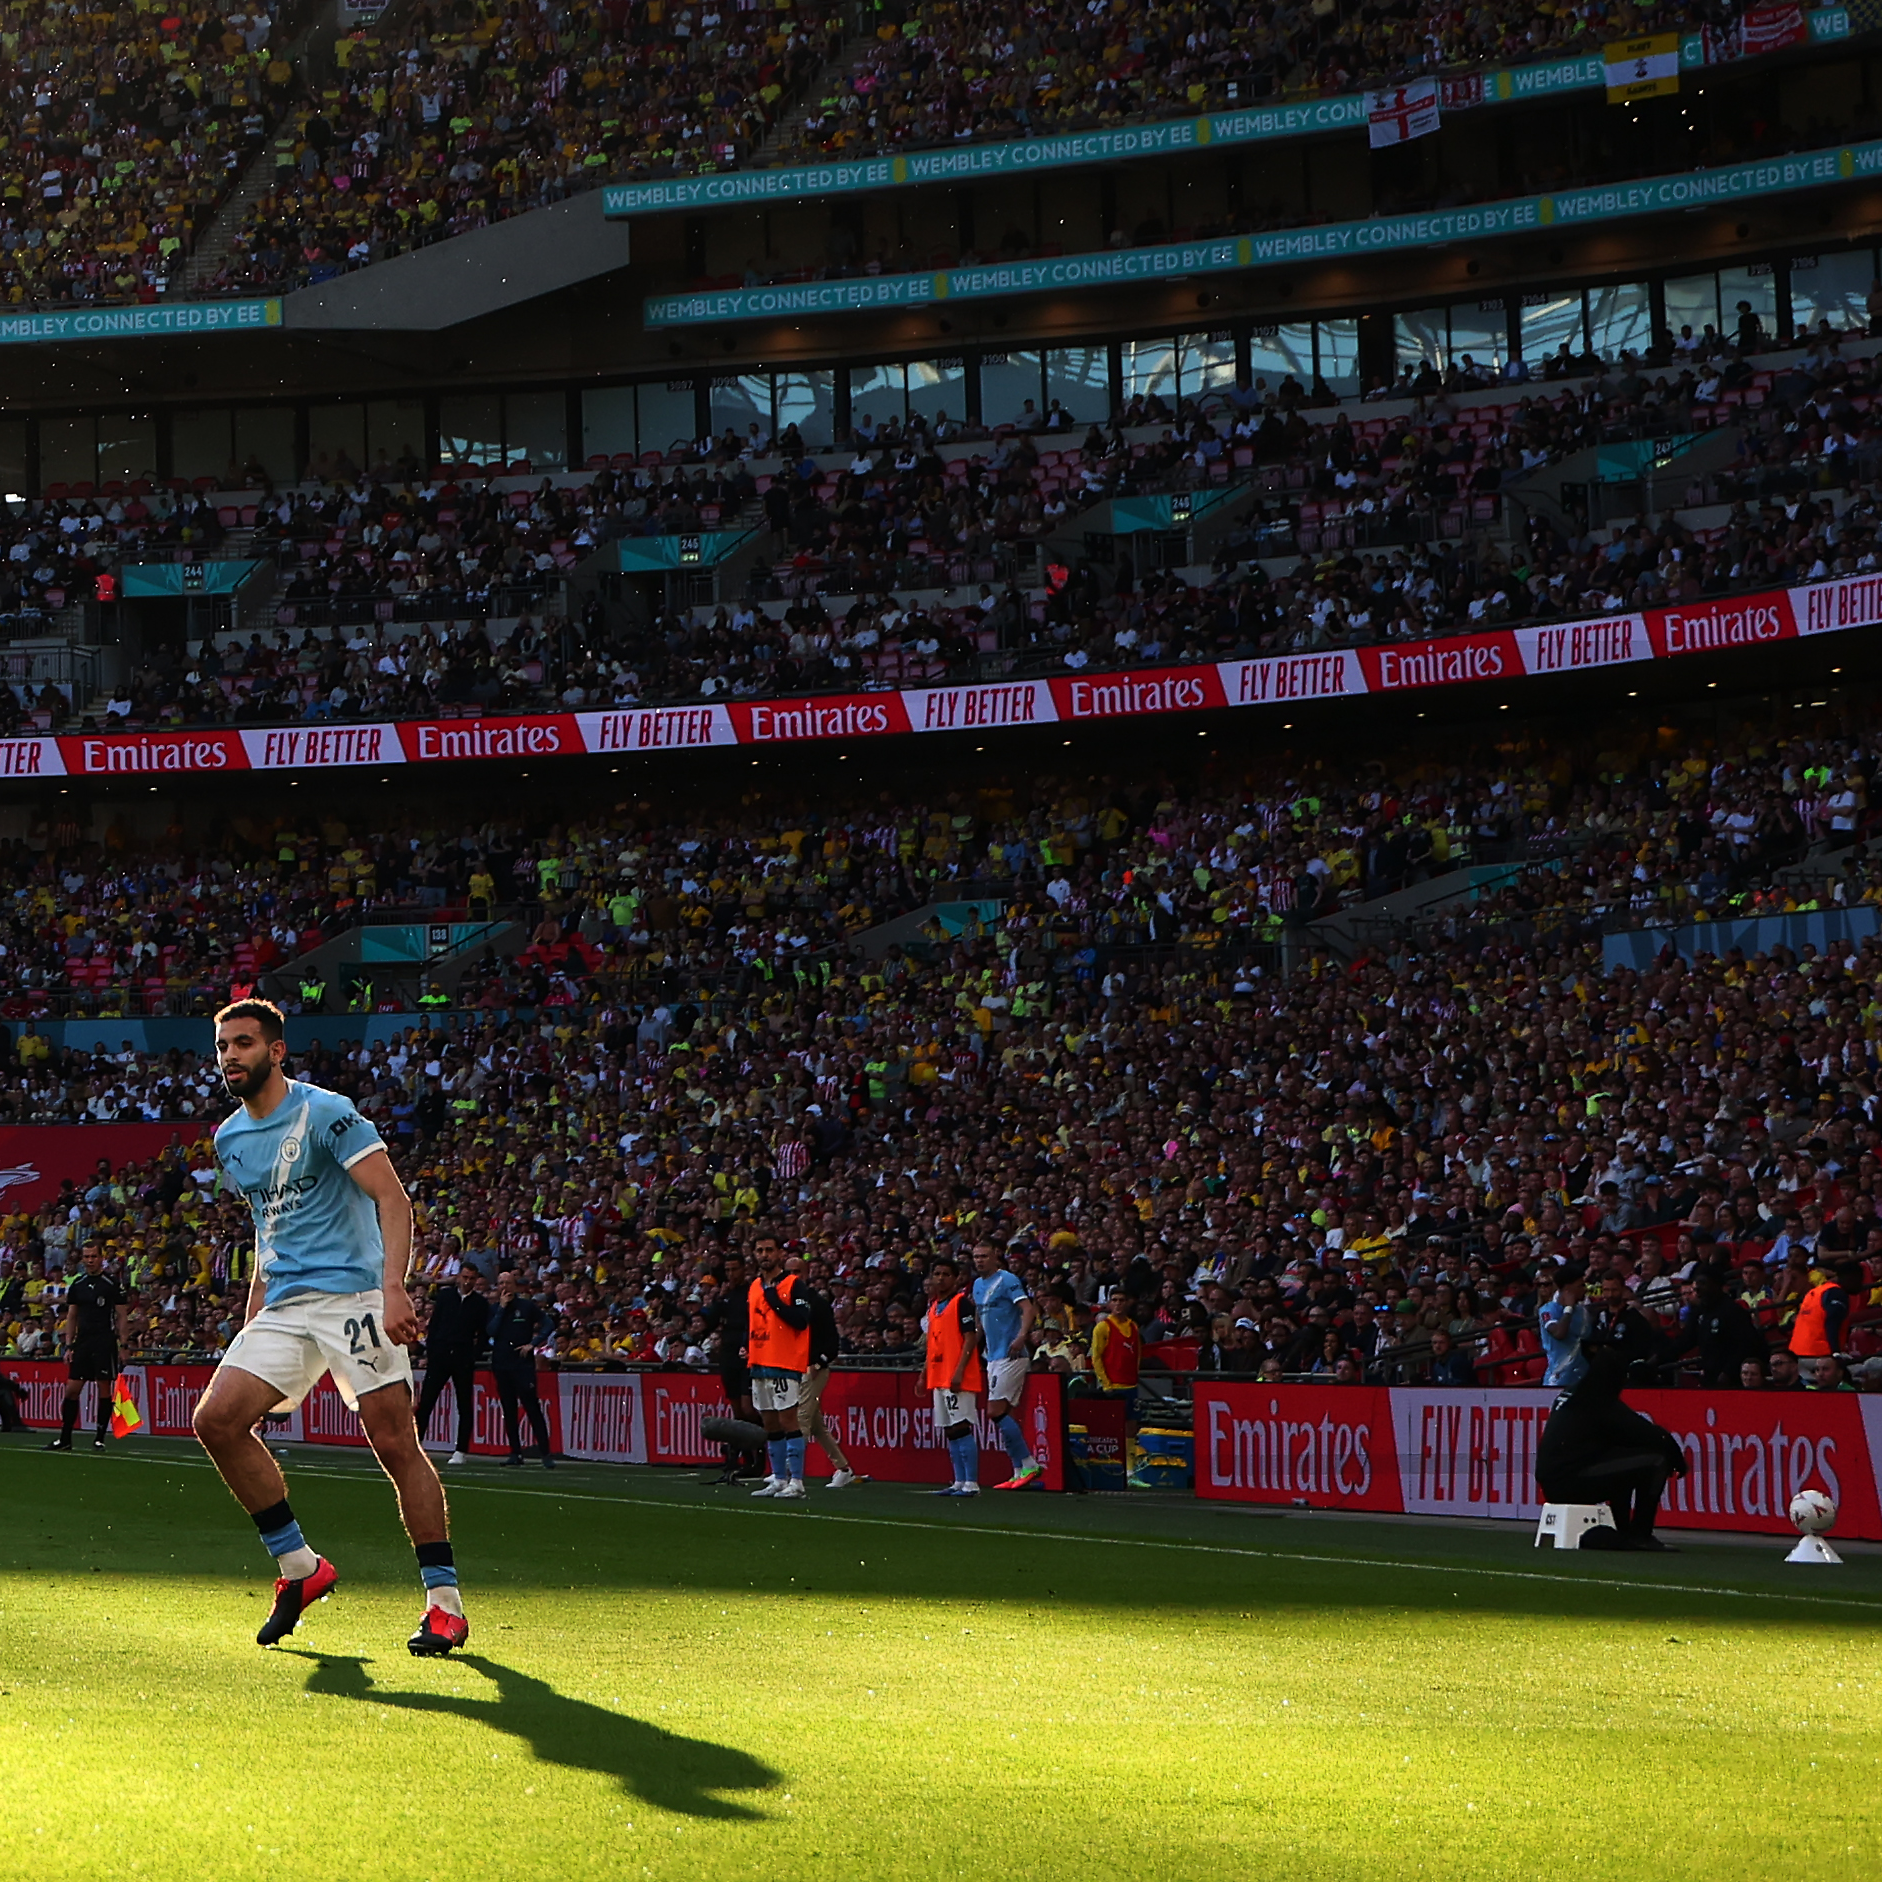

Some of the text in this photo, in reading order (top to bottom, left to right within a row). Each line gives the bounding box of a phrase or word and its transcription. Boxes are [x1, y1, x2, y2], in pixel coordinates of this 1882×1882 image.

[607, 107, 1310, 207] WEMBLEY CONNECTED BY EE WEMBLEY CONNECTED BY EE WEMBLEY
[650, 157, 1835, 319] WEMBLEY CONNECTED BY EE WEMBLEY CONNECTED BY EE
[74, 310, 201, 332] CONNECTED
[207, 308, 232, 324] BY
[238, 306, 259, 322] EE
[84, 741, 226, 771] Emirates
[265, 733, 300, 765] FLY
[304, 728, 382, 764] BETTER
[751, 703, 887, 739] Emirates
[925, 692, 960, 727] FLY
[964, 686, 1036, 725] BETTER
[1071, 678, 1203, 715] Emirates
[1240, 664, 1271, 701] FLY
[1276, 656, 1345, 698] BETTER
[1380, 646, 1502, 687] Emirates
[1537, 630, 1567, 669] FLY
[1572, 622, 1632, 665] BETTER
[1665, 606, 1779, 651] Emirates
[1806, 587, 1835, 630] FLY
[262, 1198, 303, 1219] RWAYS
[344, 1312, 382, 1356] 21
[570, 1385, 634, 1454] FLY BETTER
[848, 1406, 870, 1448] FA
[875, 1407, 908, 1450] CUP
[1209, 1401, 1370, 1495] Emirates
[1420, 1405, 1462, 1501] FLY
[1637, 1409, 1841, 1520] mirates
